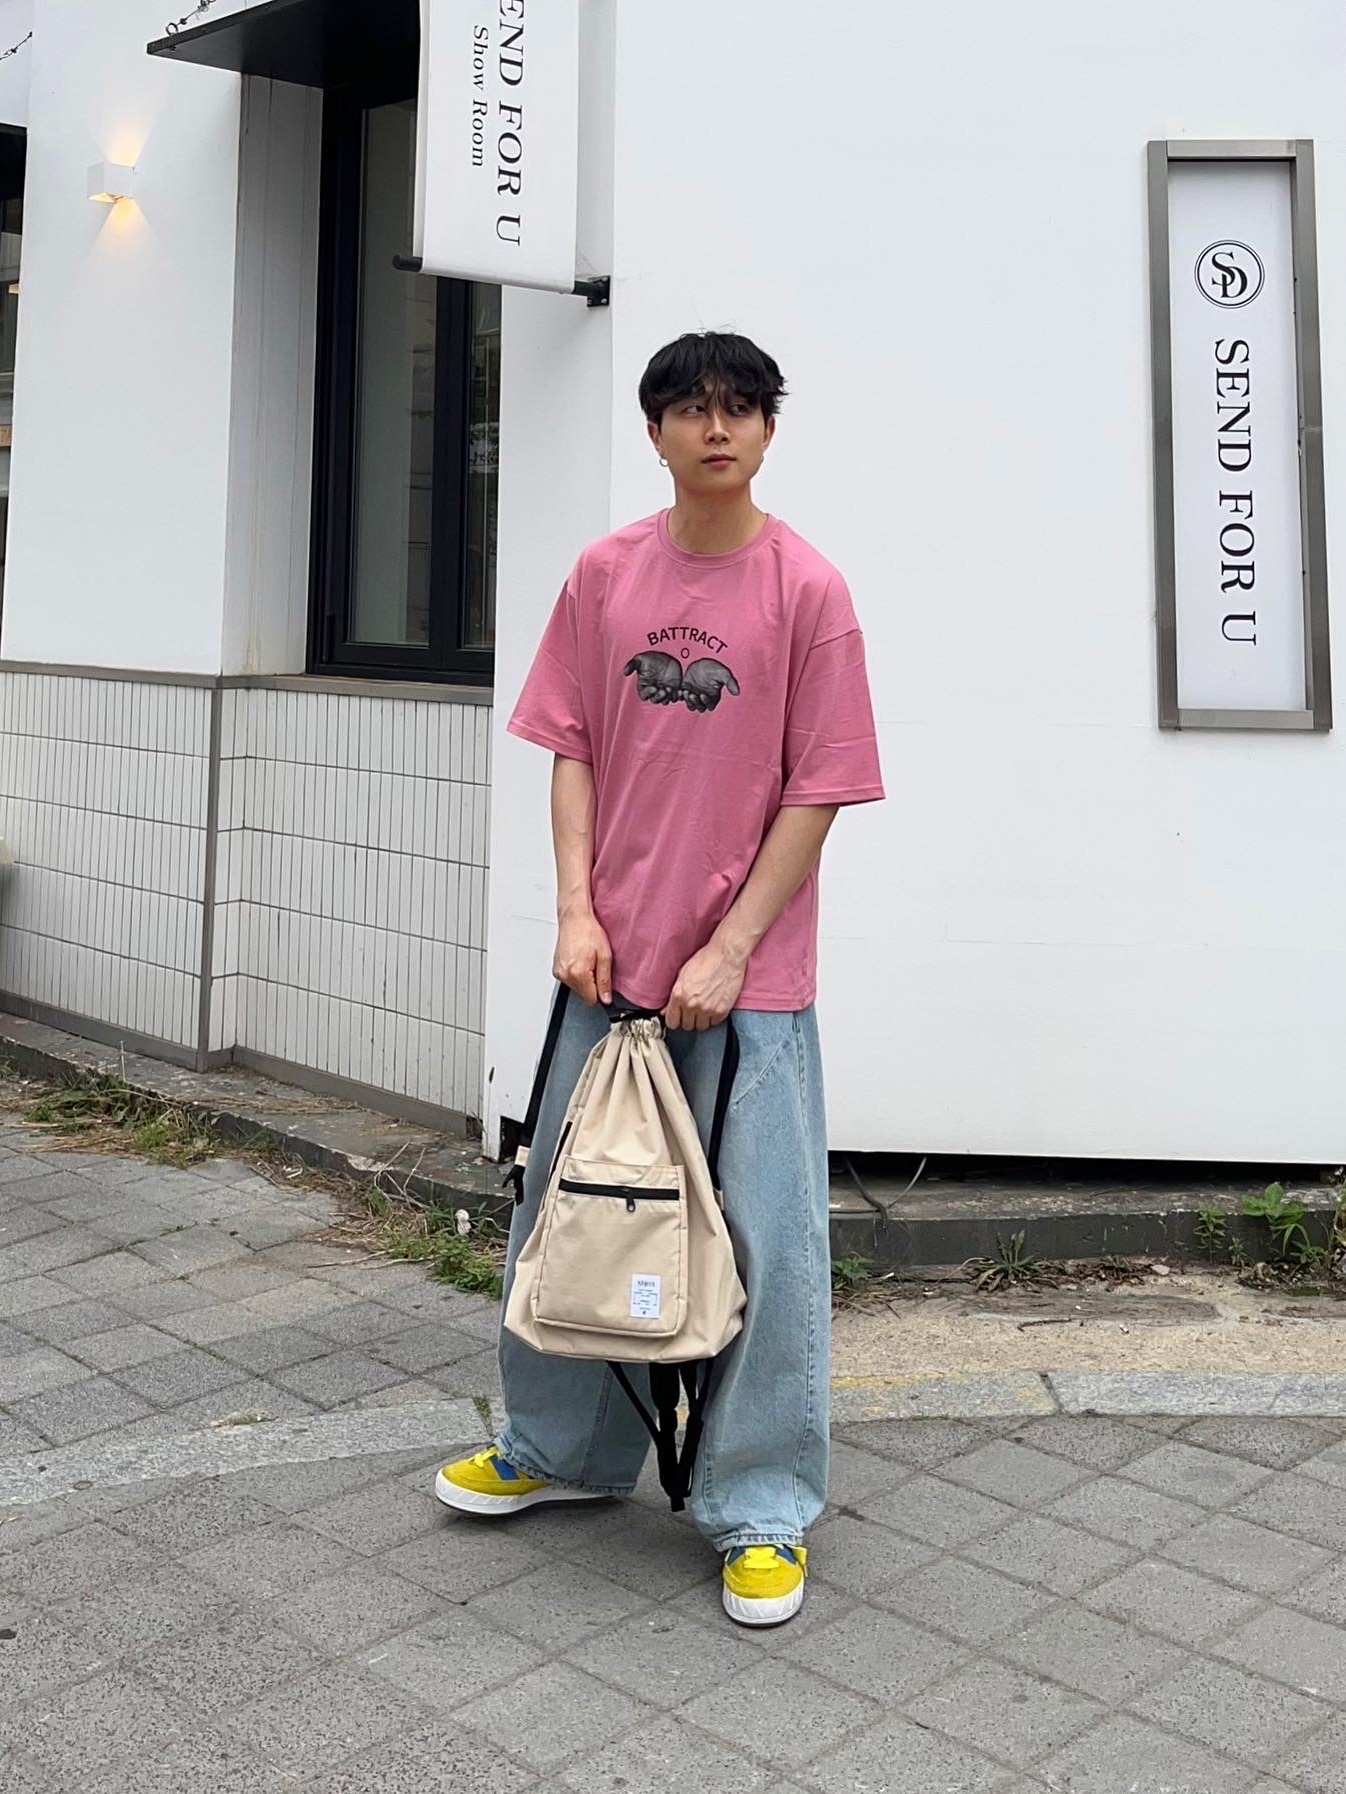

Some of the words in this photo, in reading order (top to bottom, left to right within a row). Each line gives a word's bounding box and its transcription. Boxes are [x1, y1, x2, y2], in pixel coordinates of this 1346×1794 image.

[472, 25, 489, 91] Show
[472, 99, 488, 167] Room
[497, 100, 523, 196] FOR
[496, 214, 521, 247] U
[1214, 338, 1252, 472] SEND
[1218, 489, 1256, 594] FOR
[647, 626, 728, 654] BATTRACT
[1221, 610, 1257, 646] U
